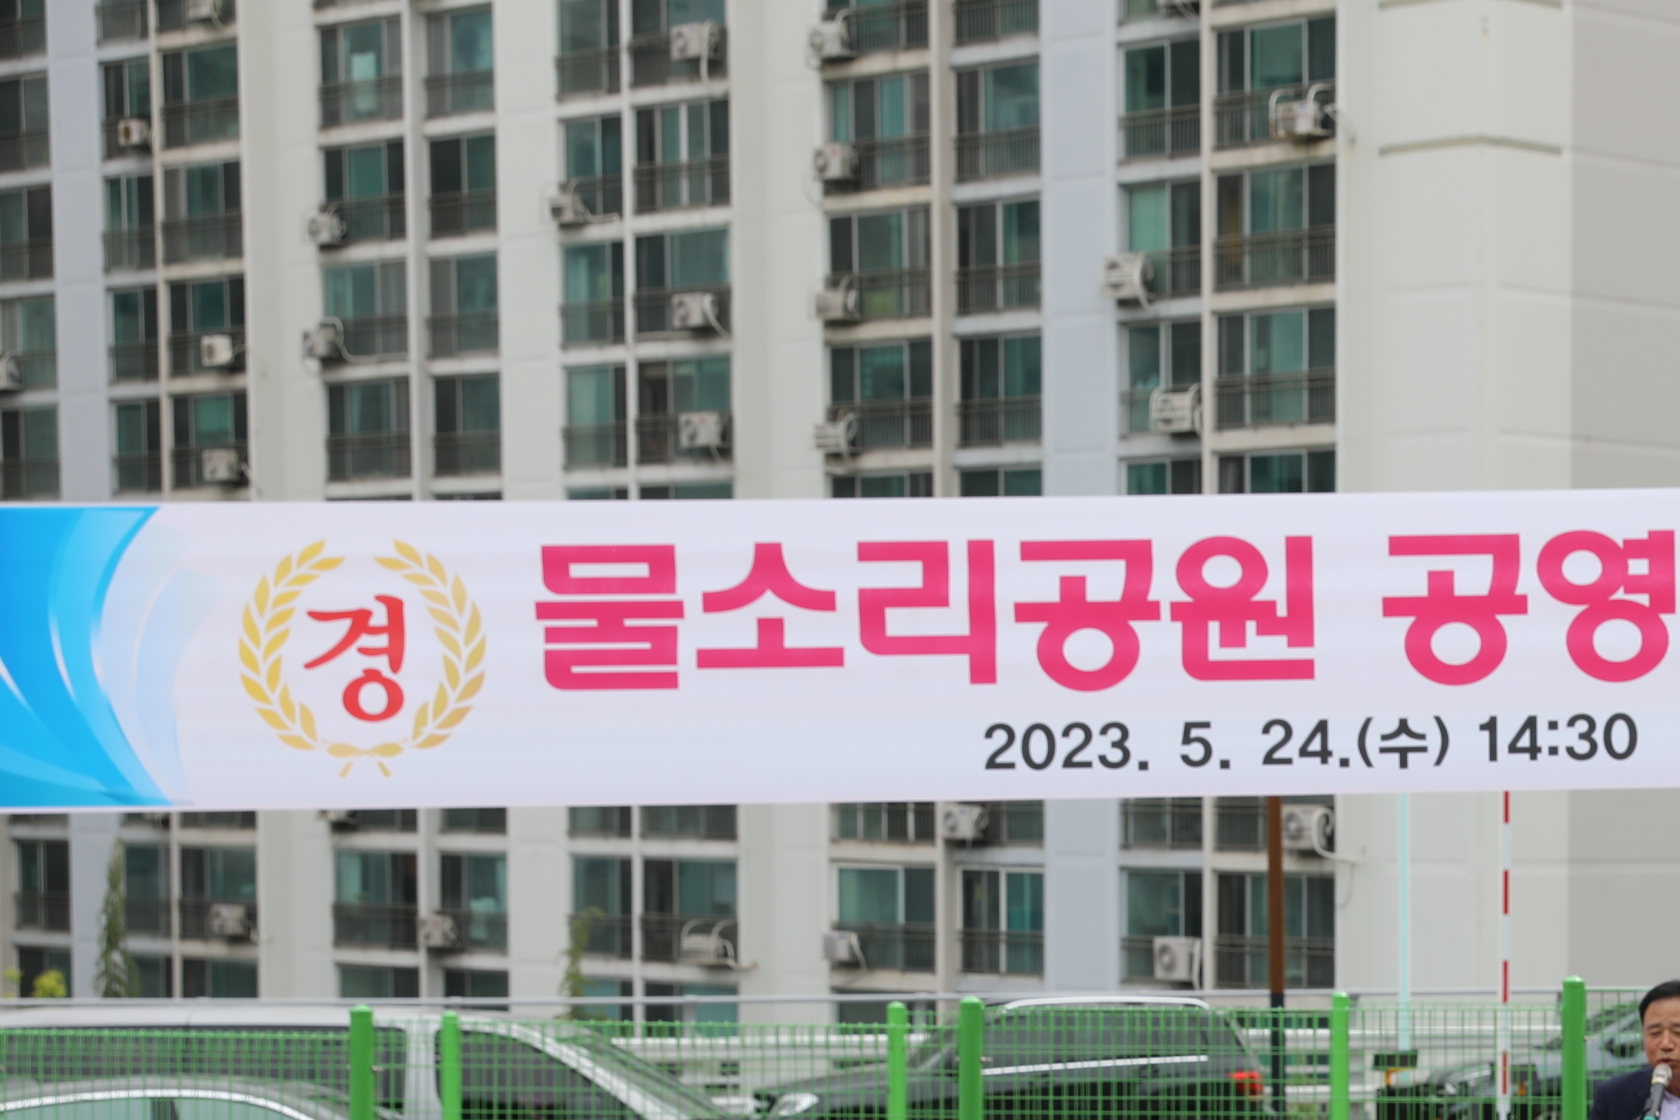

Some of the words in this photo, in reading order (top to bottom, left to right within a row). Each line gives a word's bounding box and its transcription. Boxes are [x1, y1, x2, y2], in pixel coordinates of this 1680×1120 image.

[304, 595, 406, 722] 경
[534, 536, 1316, 693] 물소리공원
[984, 721, 1149, 771] 2023.
[1180, 721, 1230, 769] 5.
[1262, 716, 1449, 769] 24.(수)
[1479, 713, 1638, 762] 14:30
